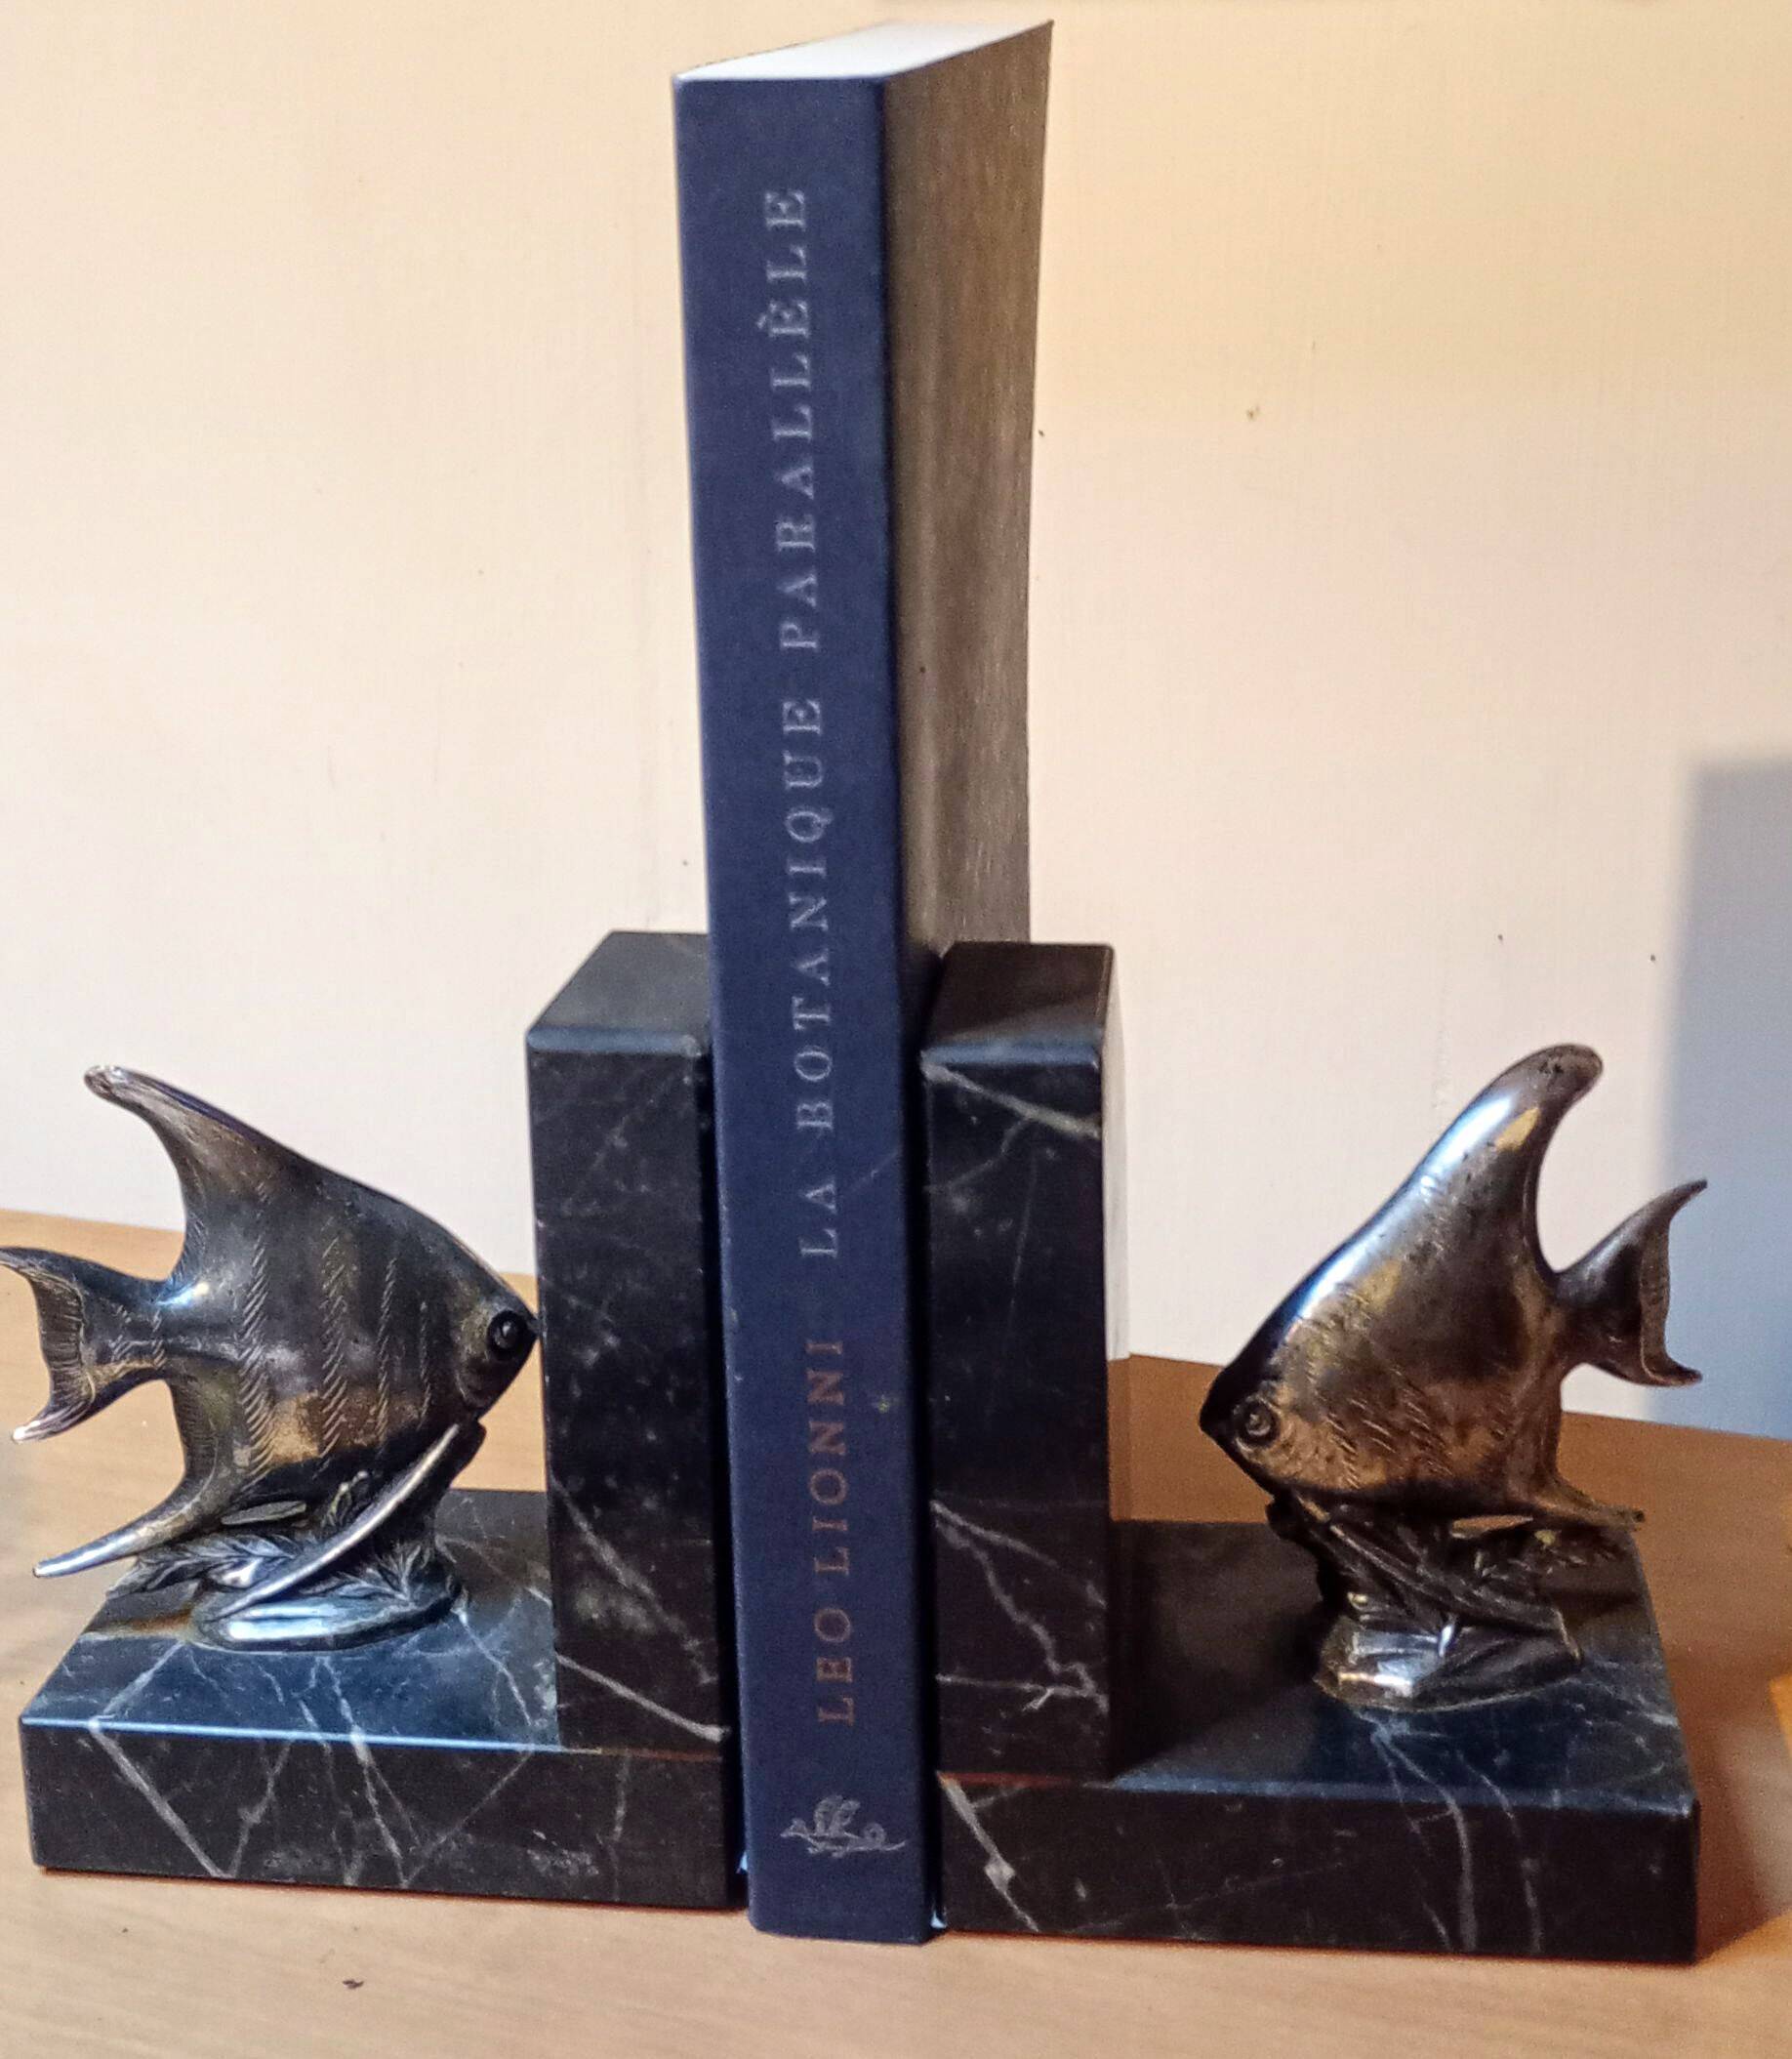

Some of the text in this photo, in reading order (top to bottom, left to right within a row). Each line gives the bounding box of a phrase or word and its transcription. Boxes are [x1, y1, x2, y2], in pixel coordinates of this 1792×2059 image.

[756, 190, 838, 1259] LA BOTANIQUE PARALLÈLE
[806, 1339, 856, 1726] LEO LIONNI
